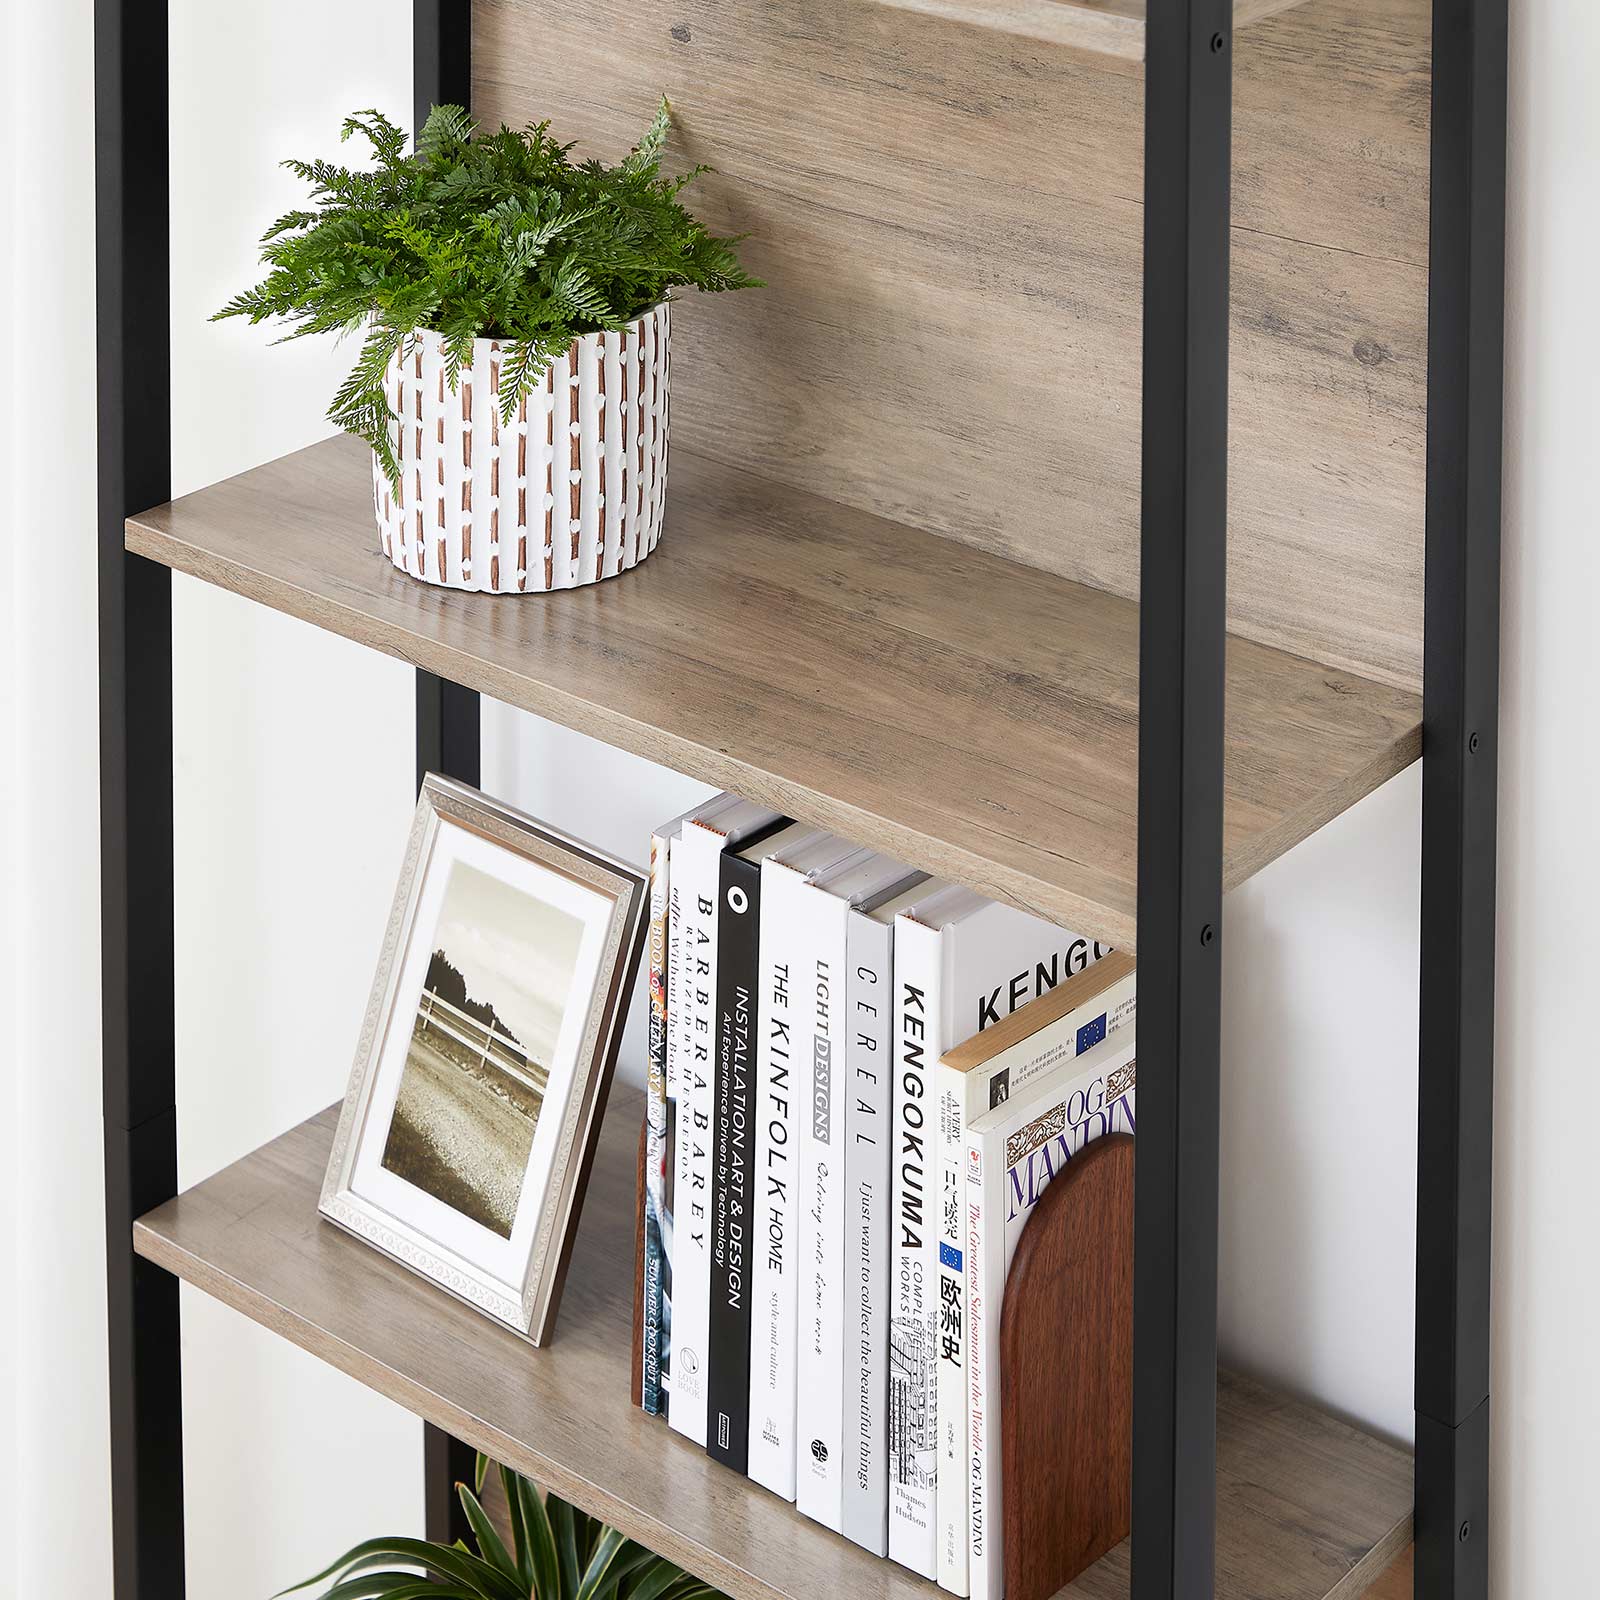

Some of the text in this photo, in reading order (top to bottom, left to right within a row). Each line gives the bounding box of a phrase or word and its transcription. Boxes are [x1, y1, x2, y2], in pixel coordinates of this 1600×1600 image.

[651, 893, 663, 922] BIG
[651, 923, 663, 975] BOOK
[669, 937, 680, 1006] Without
[651, 977, 660, 994] OF
[683, 926, 693, 1026] REALIZED
[668, 1010, 678, 1037] The
[682, 1034, 691, 1057] BY
[668, 1041, 677, 1085] Book
[691, 894, 713, 1249] BARBERA BAREY
[856, 966, 878, 1144] CEREAL
[768, 963, 790, 1274] THE KINFOLK HOME
[1067, 1077, 1106, 1126] OG
[716, 1011, 732, 1268] Art Experience Driven by Technology
[727, 985, 749, 1309] INSTALLATION ART & DESIGN
[859, 1187, 873, 1220] just
[861, 1225, 872, 1264] want
[861, 1266, 872, 1282] to
[900, 1256, 910, 1313] WORKS
[646, 1258, 657, 1385] SUMMER COOKOUT
[860, 1284, 872, 1337] collect
[940, 1274, 962, 1368] 欧洲史
[769, 1291, 780, 1390] style and culture
[861, 1339, 872, 1366] the
[860, 1368, 872, 1439] beautiful
[968, 1203, 983, 1557] The Greatest Salesman in the World OG MANDINO
[857, 1441, 871, 1491] things
[895, 1486, 926, 1509] Thames
[895, 1506, 926, 1528] Hudson
